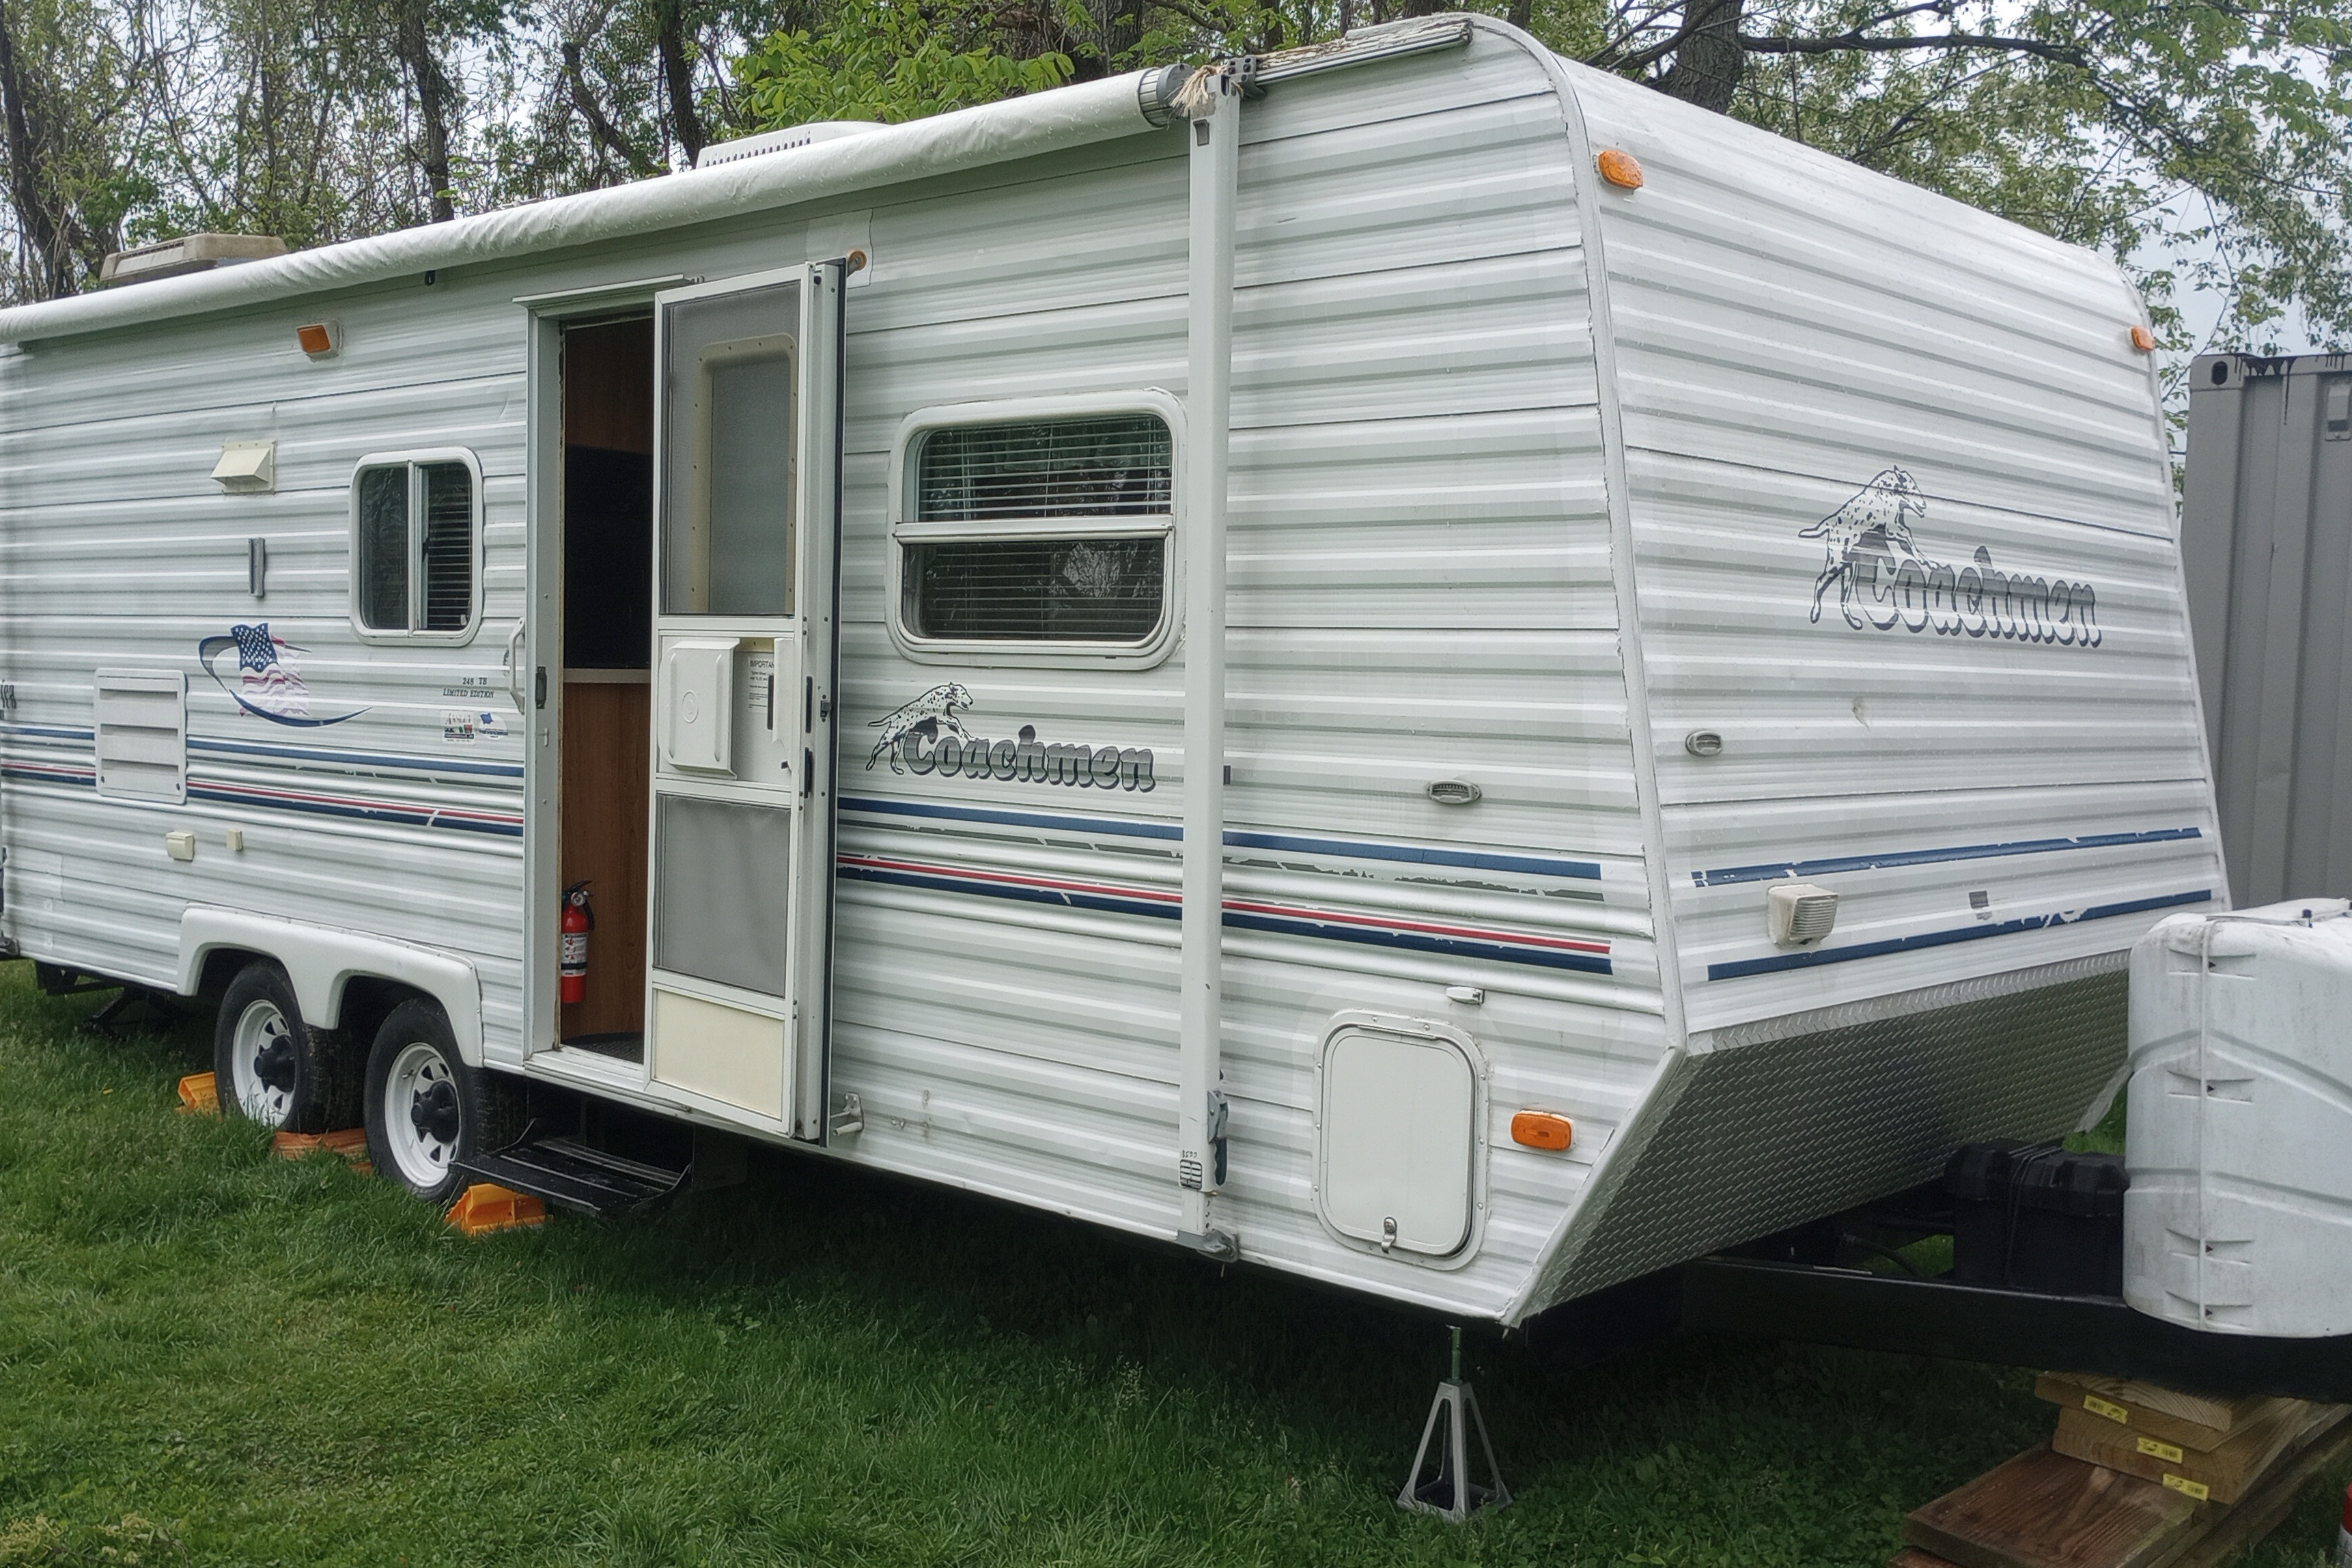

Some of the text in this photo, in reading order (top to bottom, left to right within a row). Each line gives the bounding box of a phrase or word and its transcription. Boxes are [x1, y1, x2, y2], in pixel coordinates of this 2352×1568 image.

[1844, 524, 2101, 647] Coachmen
[750, 660, 774, 668] IMPORTAN
[443, 688, 494, 698] LIMITED EDITION
[904, 717, 1156, 792] Coachmen
